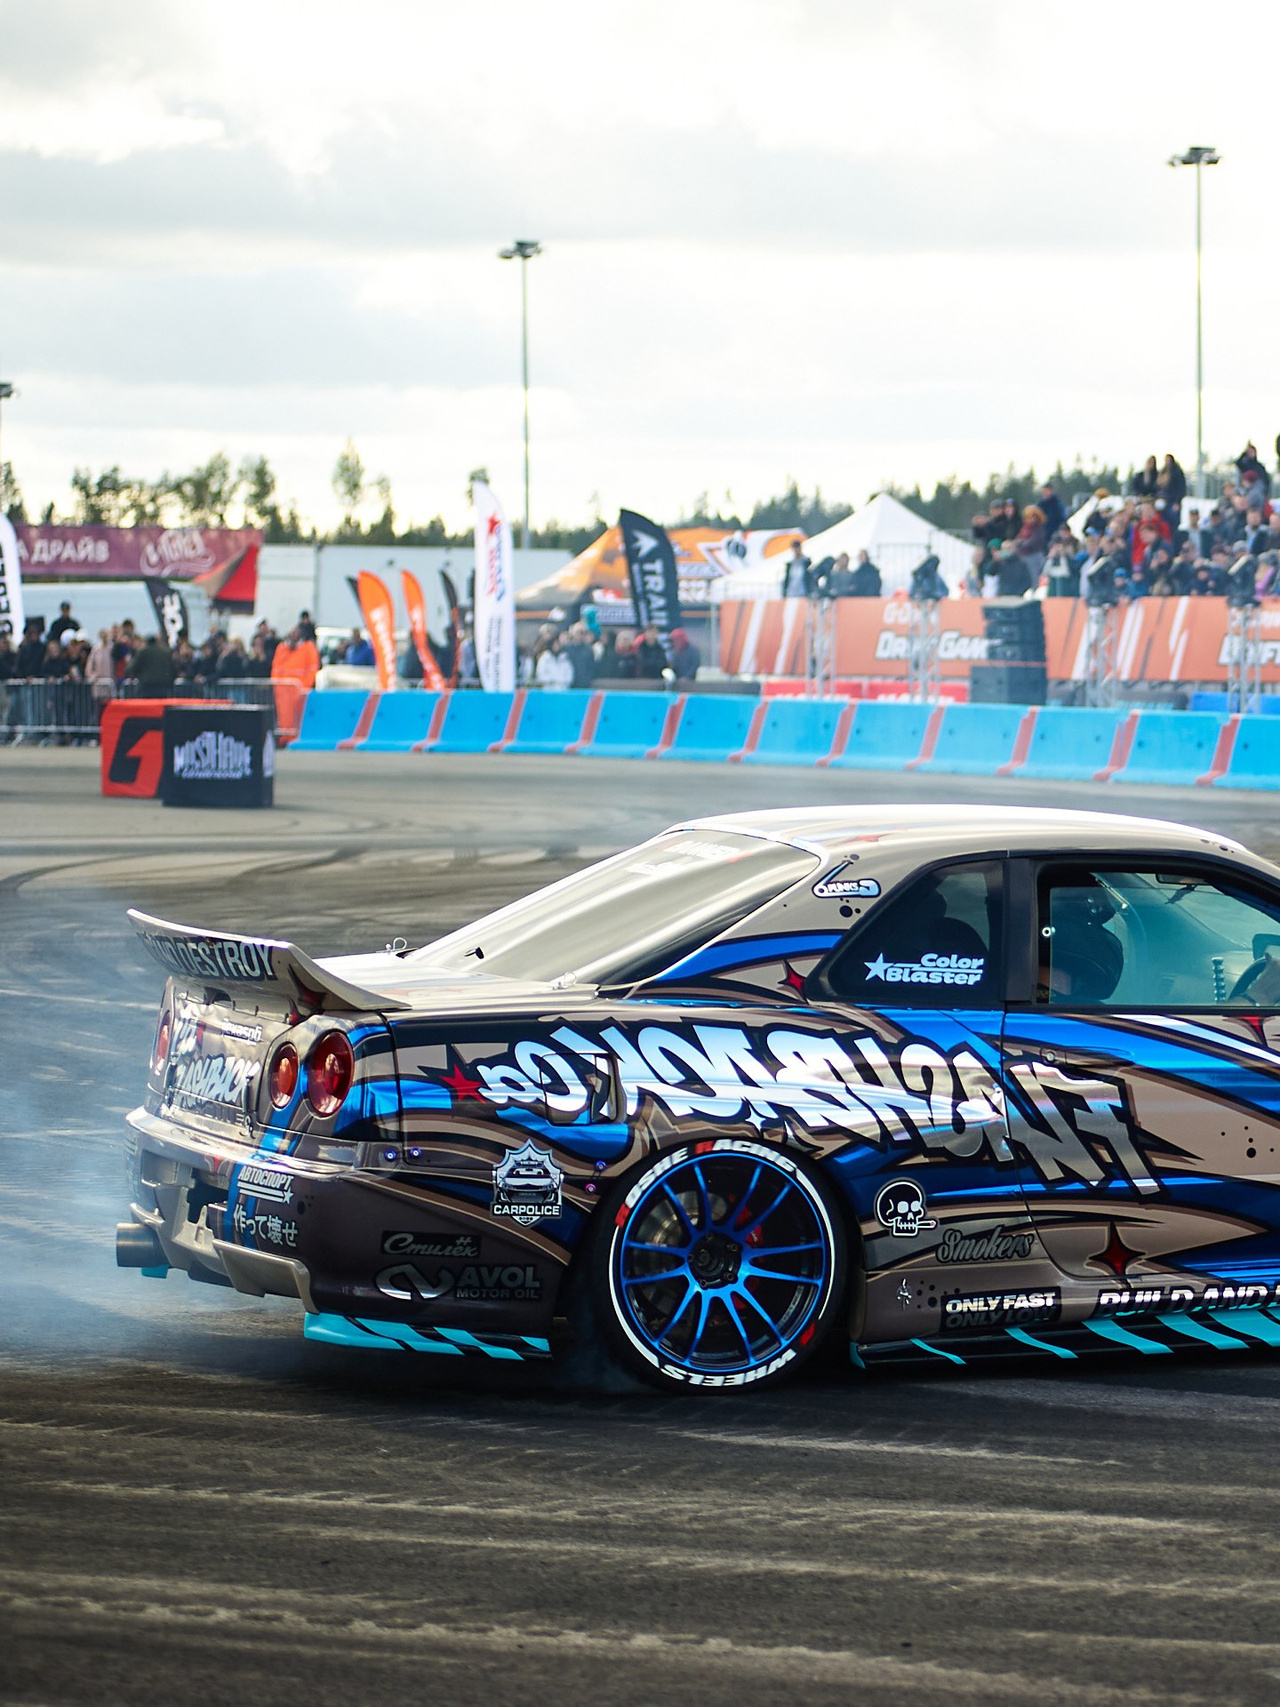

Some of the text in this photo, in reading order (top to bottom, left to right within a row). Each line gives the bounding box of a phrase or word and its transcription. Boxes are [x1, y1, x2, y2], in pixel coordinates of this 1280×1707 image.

[31, 535, 110, 564] ДРАЙВ
[176, 940, 273, 977] DESTROY
[920, 953, 984, 970] Color
[885, 967, 981, 986] Blaster
[238, 1165, 294, 1190] АВТОСПОРТ
[493, 1204, 560, 1215] CARPOLICE
[233, 1203, 298, 1247] 作って壊せ
[937, 1228, 1034, 1263] Smokers
[456, 1288, 539, 1299] MOTOR OIL
[945, 1291, 1056, 1314] ONLY FAST
[1192, 1285, 1269, 1312] AND
[945, 1311, 1004, 1329] ONLY
[661, 1348, 797, 1387] WHEELS
